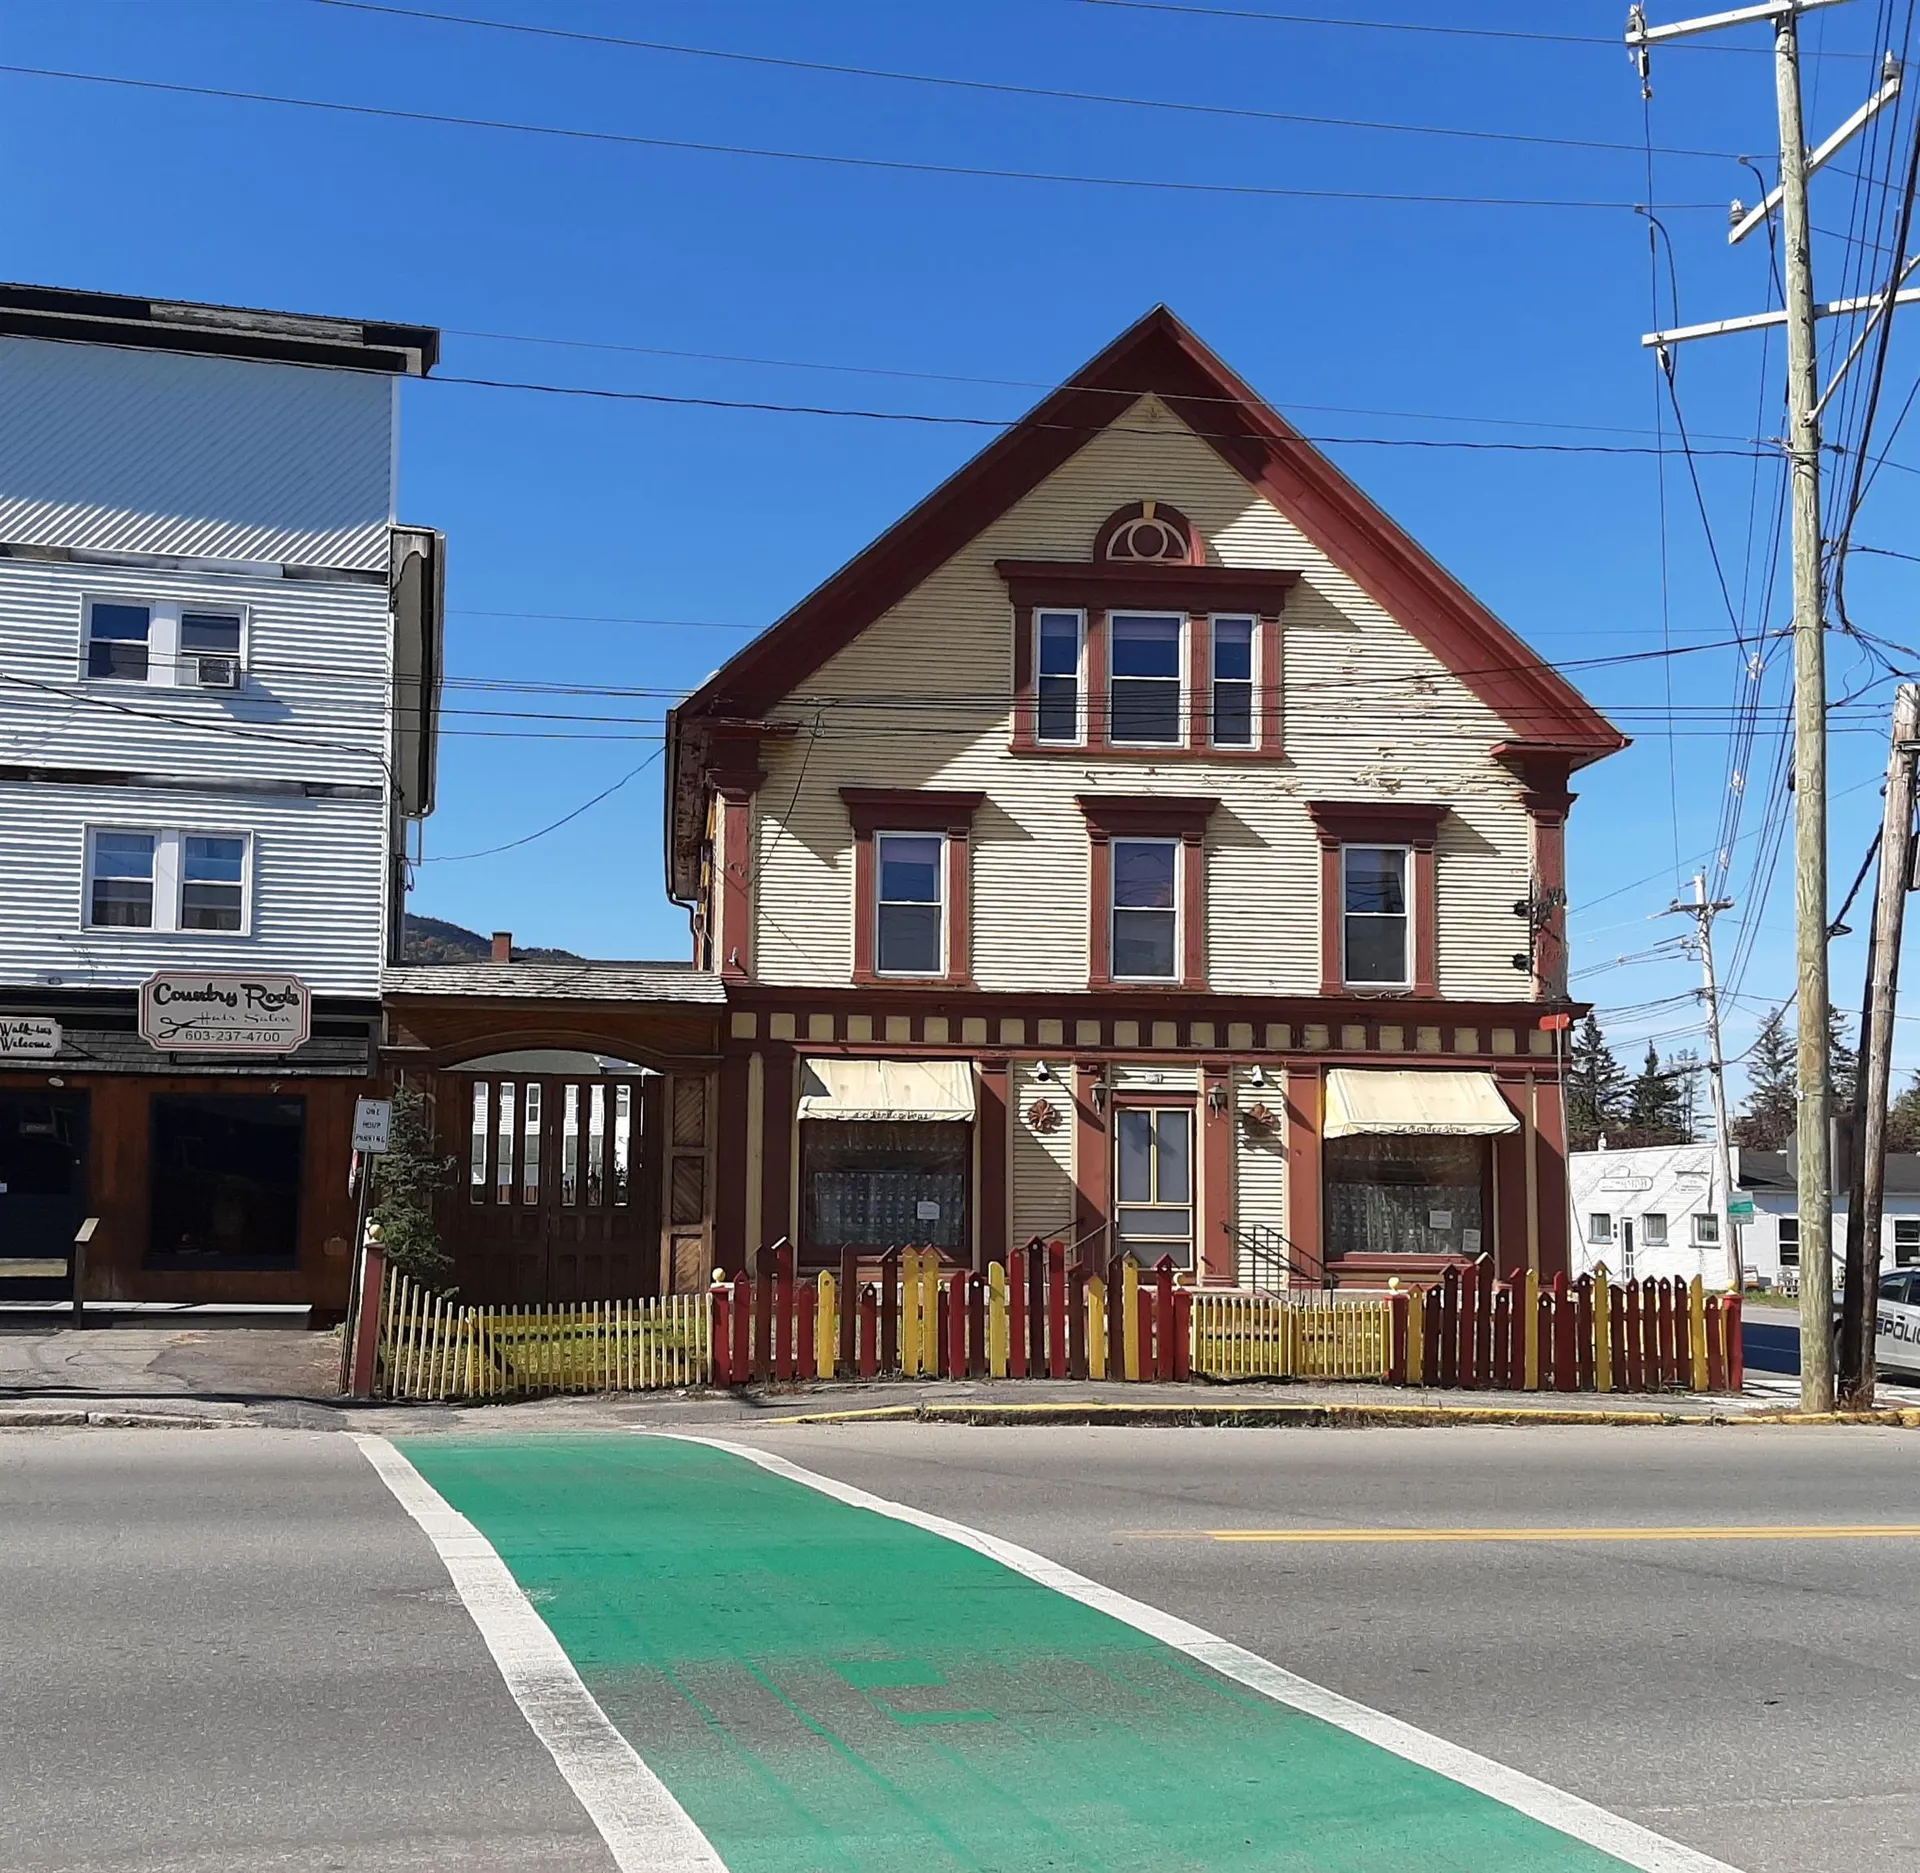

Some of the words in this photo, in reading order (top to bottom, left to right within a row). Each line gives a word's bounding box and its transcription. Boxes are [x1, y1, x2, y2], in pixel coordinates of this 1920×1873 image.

[153, 982, 238, 1008] Country
[240, 983, 300, 1012] Roots
[193, 1011, 238, 1026] Hair
[243, 1012, 292, 1025] Salon
[185, 1030, 280, 1043] 603-237-4700
[0, 1036, 53, 1052] Welcome
[365, 1107, 381, 1116] ONE
[356, 1134, 386, 1143] PARKING
